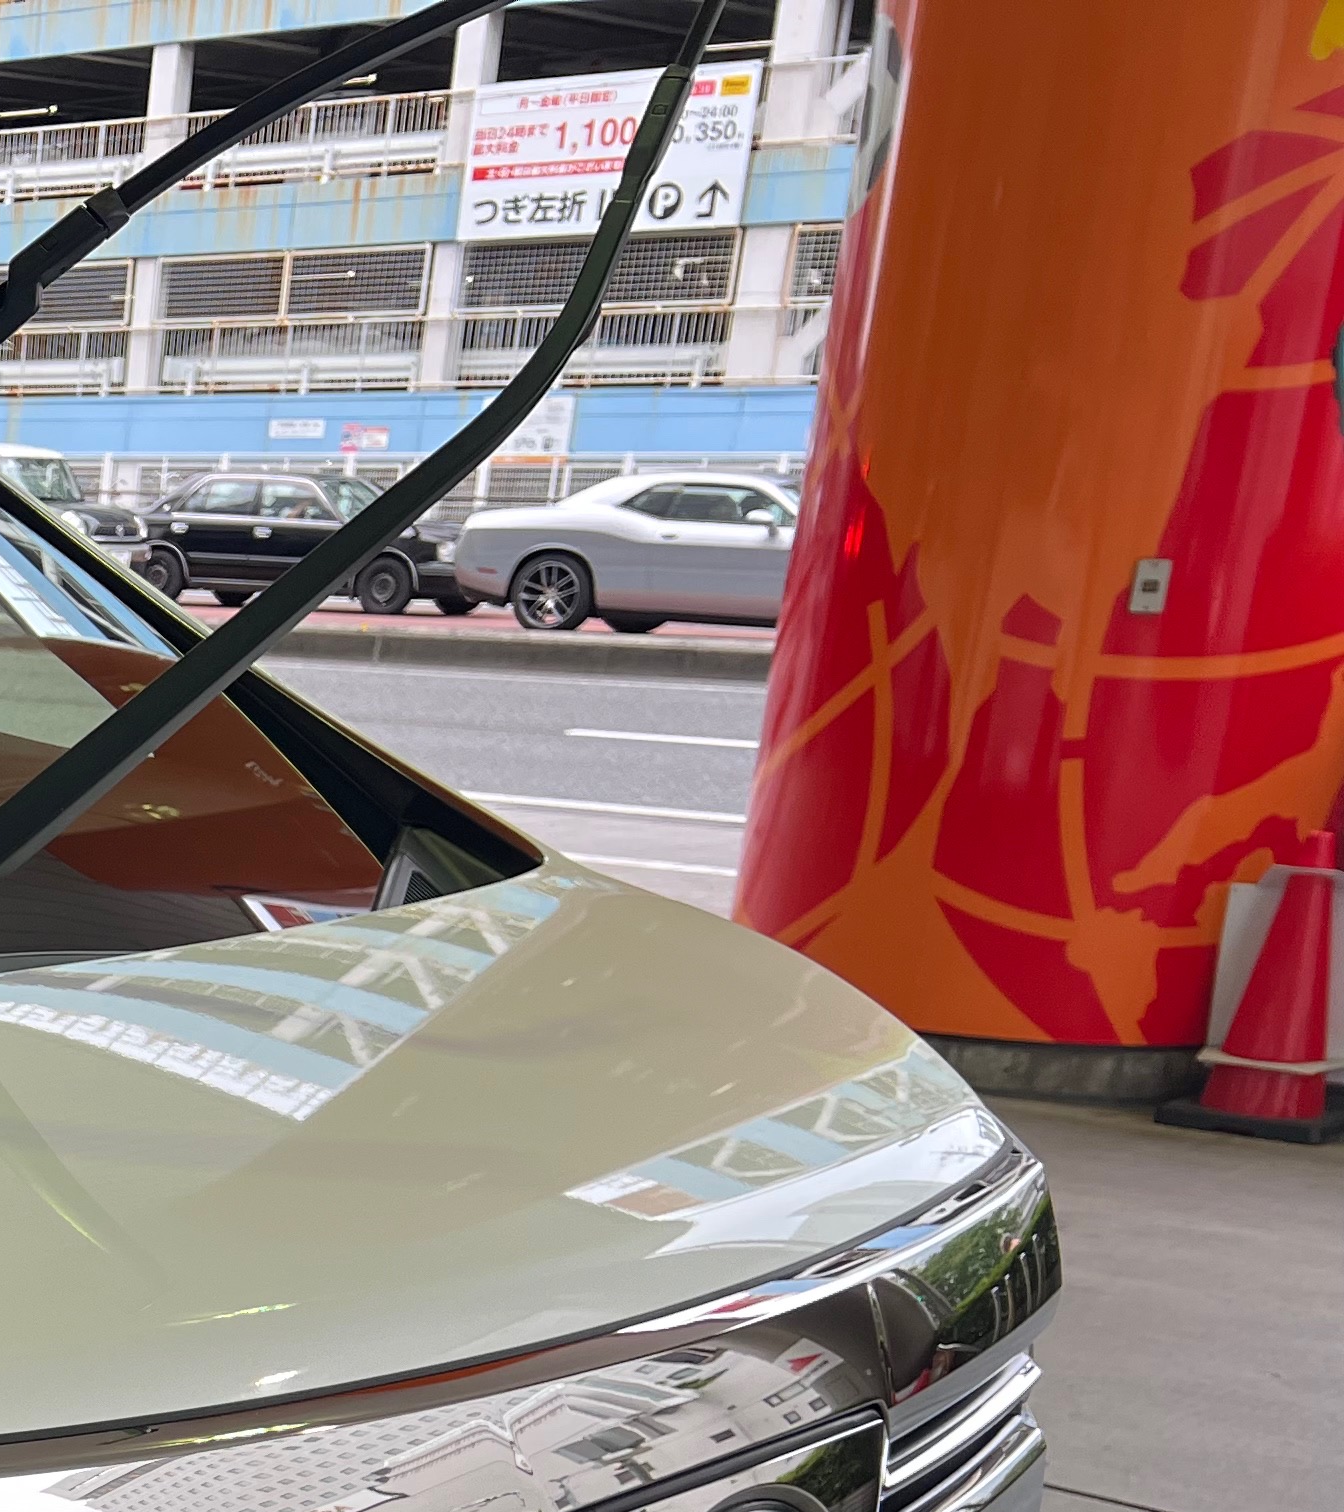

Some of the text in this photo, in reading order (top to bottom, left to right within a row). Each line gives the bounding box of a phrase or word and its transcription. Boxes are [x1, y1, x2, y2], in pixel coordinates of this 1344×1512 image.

[555, 116, 638, 155] 1,100
[473, 189, 588, 224] つぎ左折
